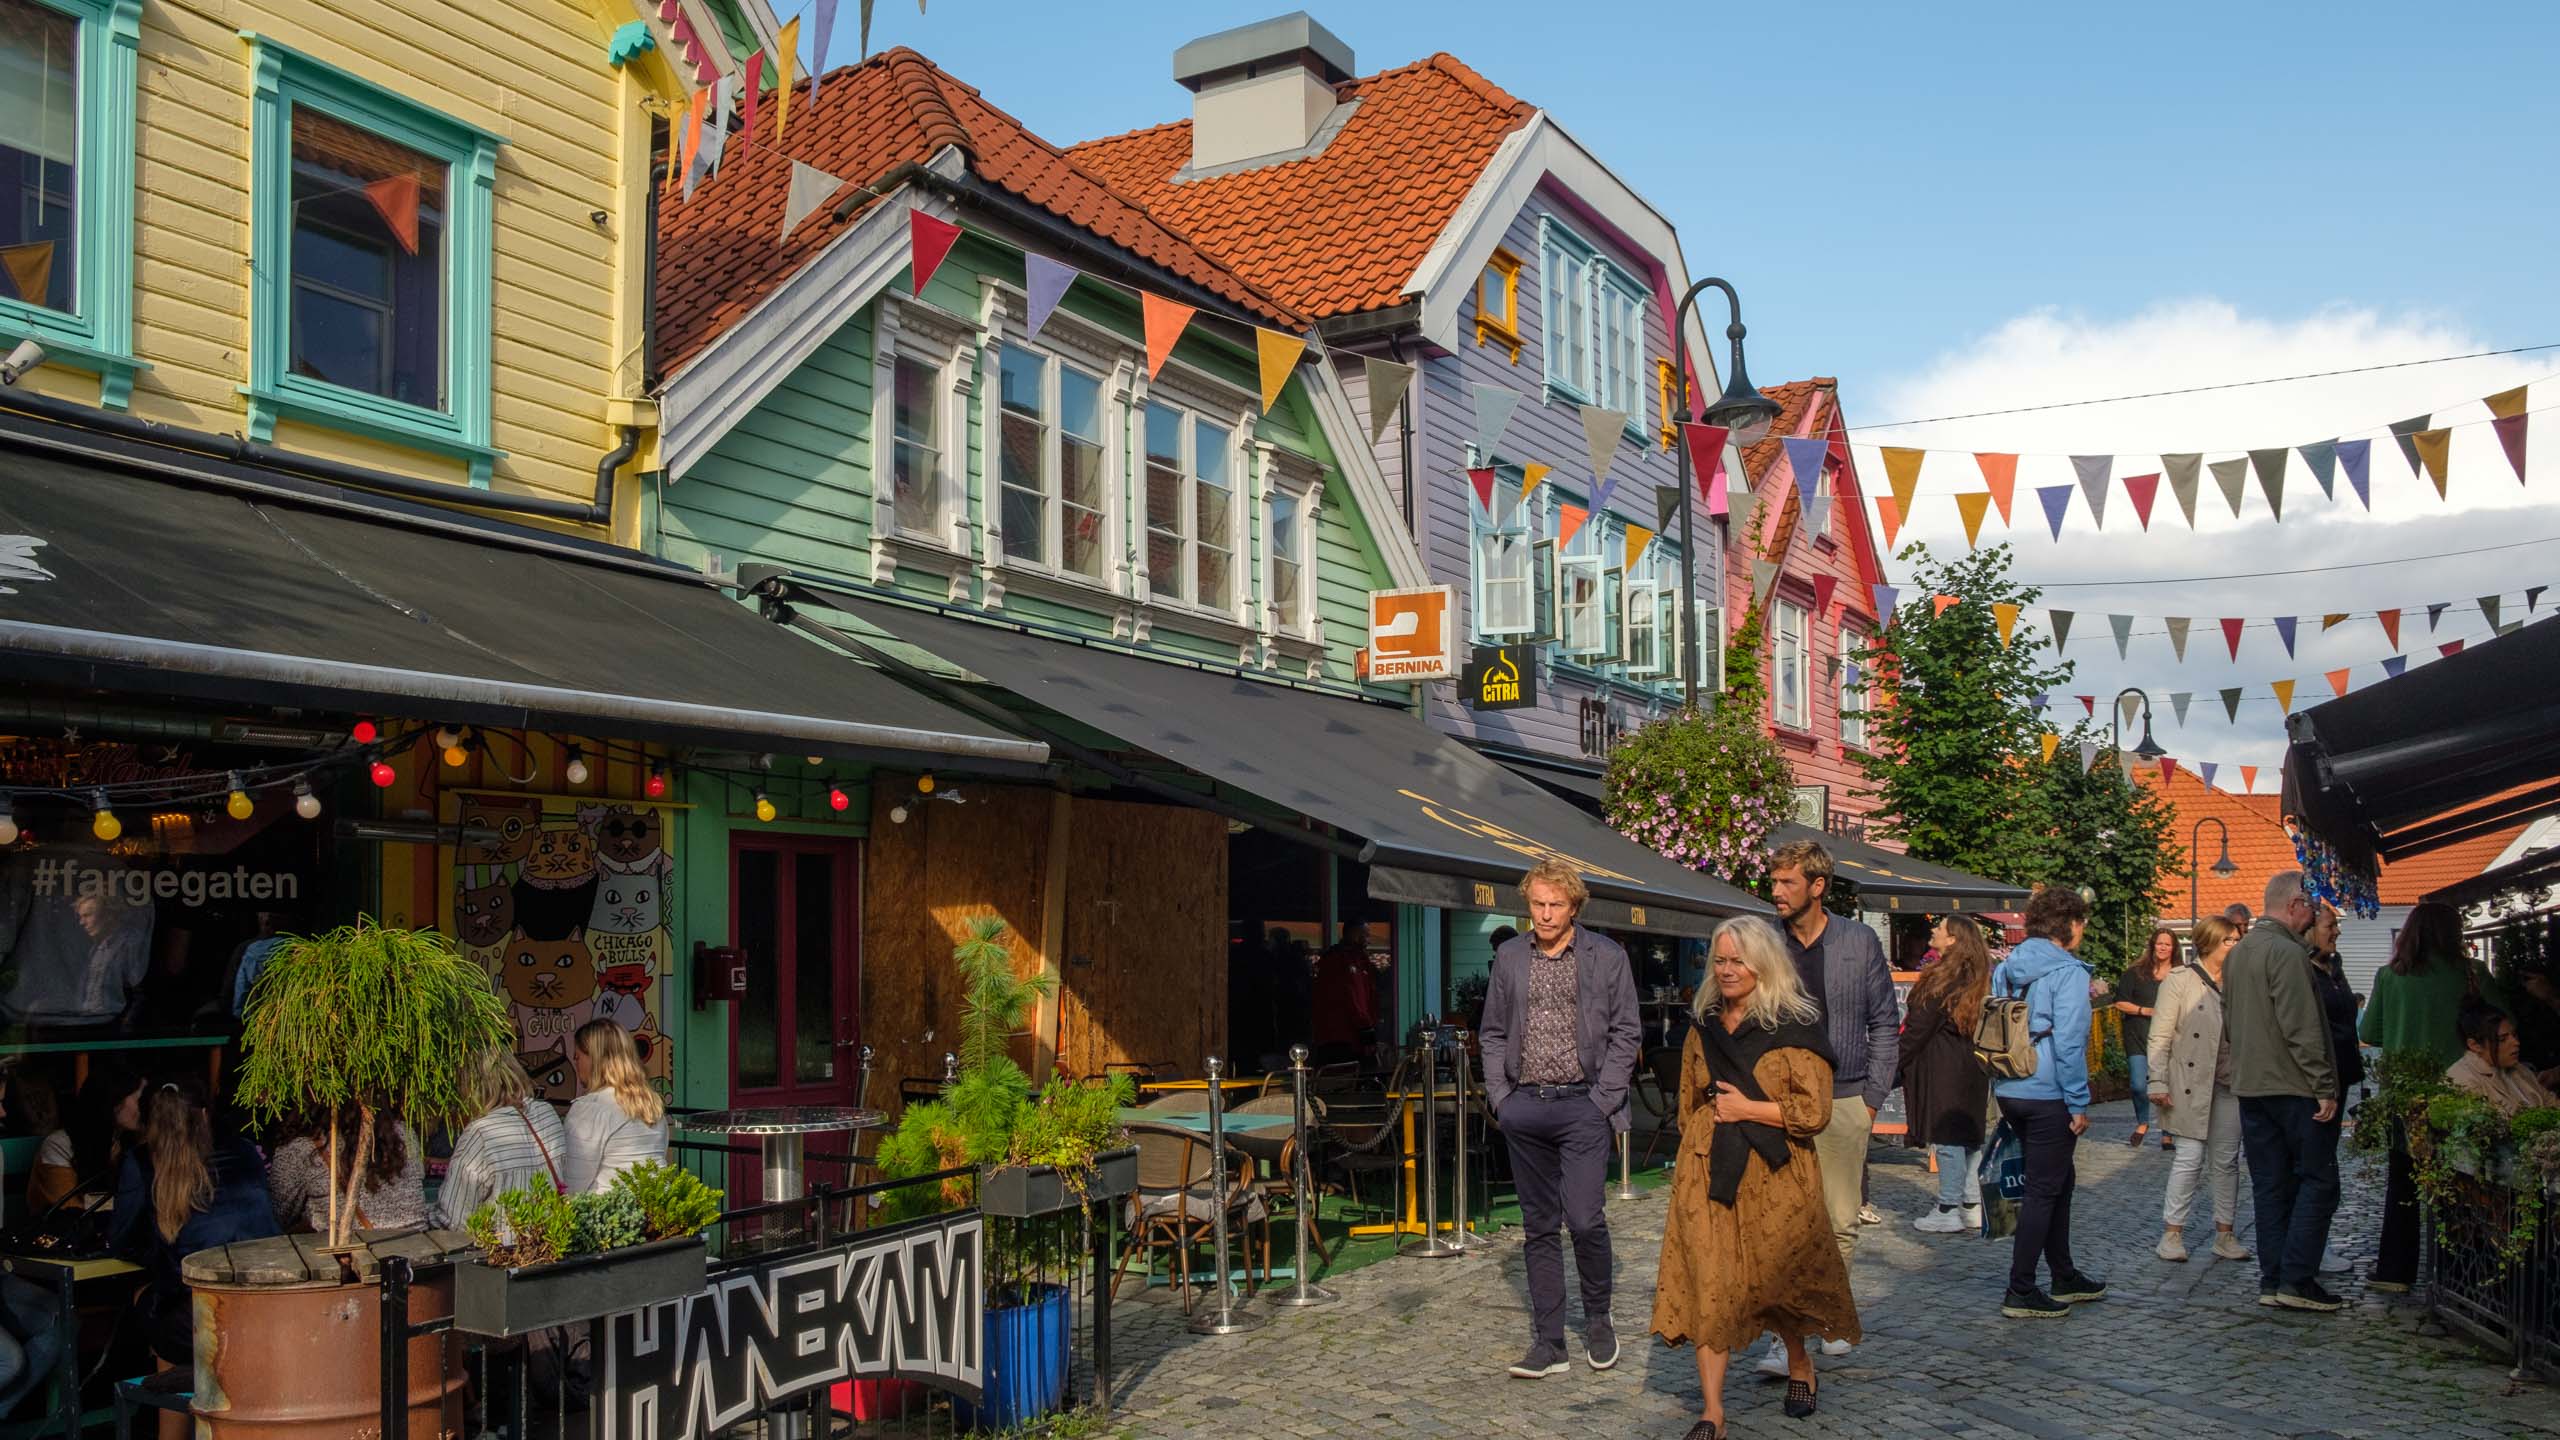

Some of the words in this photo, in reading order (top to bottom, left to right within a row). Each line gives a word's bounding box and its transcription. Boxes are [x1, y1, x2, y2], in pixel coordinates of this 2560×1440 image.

[1375, 659, 1444, 676] BERNINA
[32, 859, 298, 906] #fargegaten
[594, 935, 653, 950] CHICAGO
[608, 949, 646, 963] BULLS
[527, 1013, 577, 1037] GUCCI
[604, 1219, 983, 1440] HANEKAM
